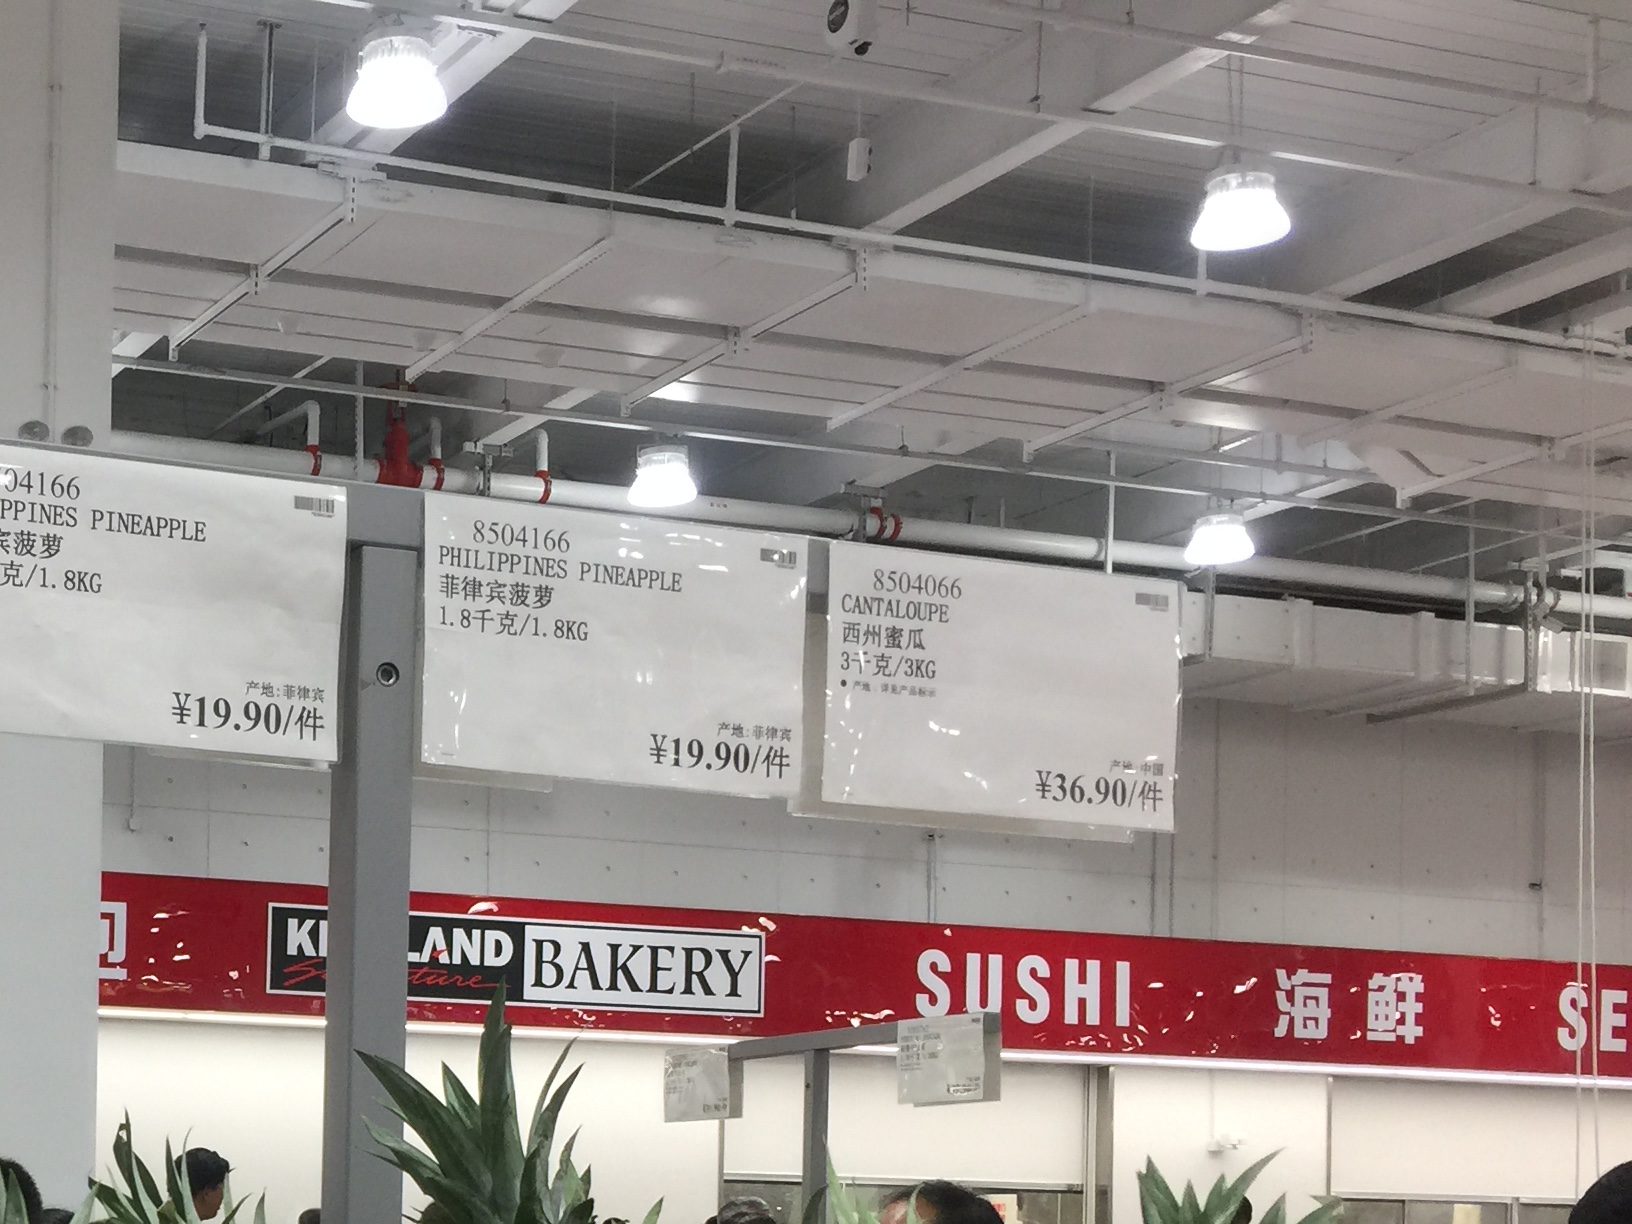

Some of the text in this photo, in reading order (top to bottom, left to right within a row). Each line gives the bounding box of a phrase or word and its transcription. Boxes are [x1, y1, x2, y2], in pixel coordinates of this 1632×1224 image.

[91, 510, 207, 542] PINEAPPLE
[473, 520, 570, 553] 8504166
[439, 545, 682, 592] PHILIPPINES PINEAPPLE
[873, 569, 962, 599] 8504066
[439, 573, 554, 609] 菲律宾菠萝
[841, 594, 950, 623] CANTALOUPE
[842, 622, 926, 651] 西州蜜瓜
[531, 938, 753, 999] BAKERY
[915, 948, 1131, 1028] SUSHI
[1274, 967, 1425, 1046] 海鲜
[1558, 986, 1627, 1052] SE
